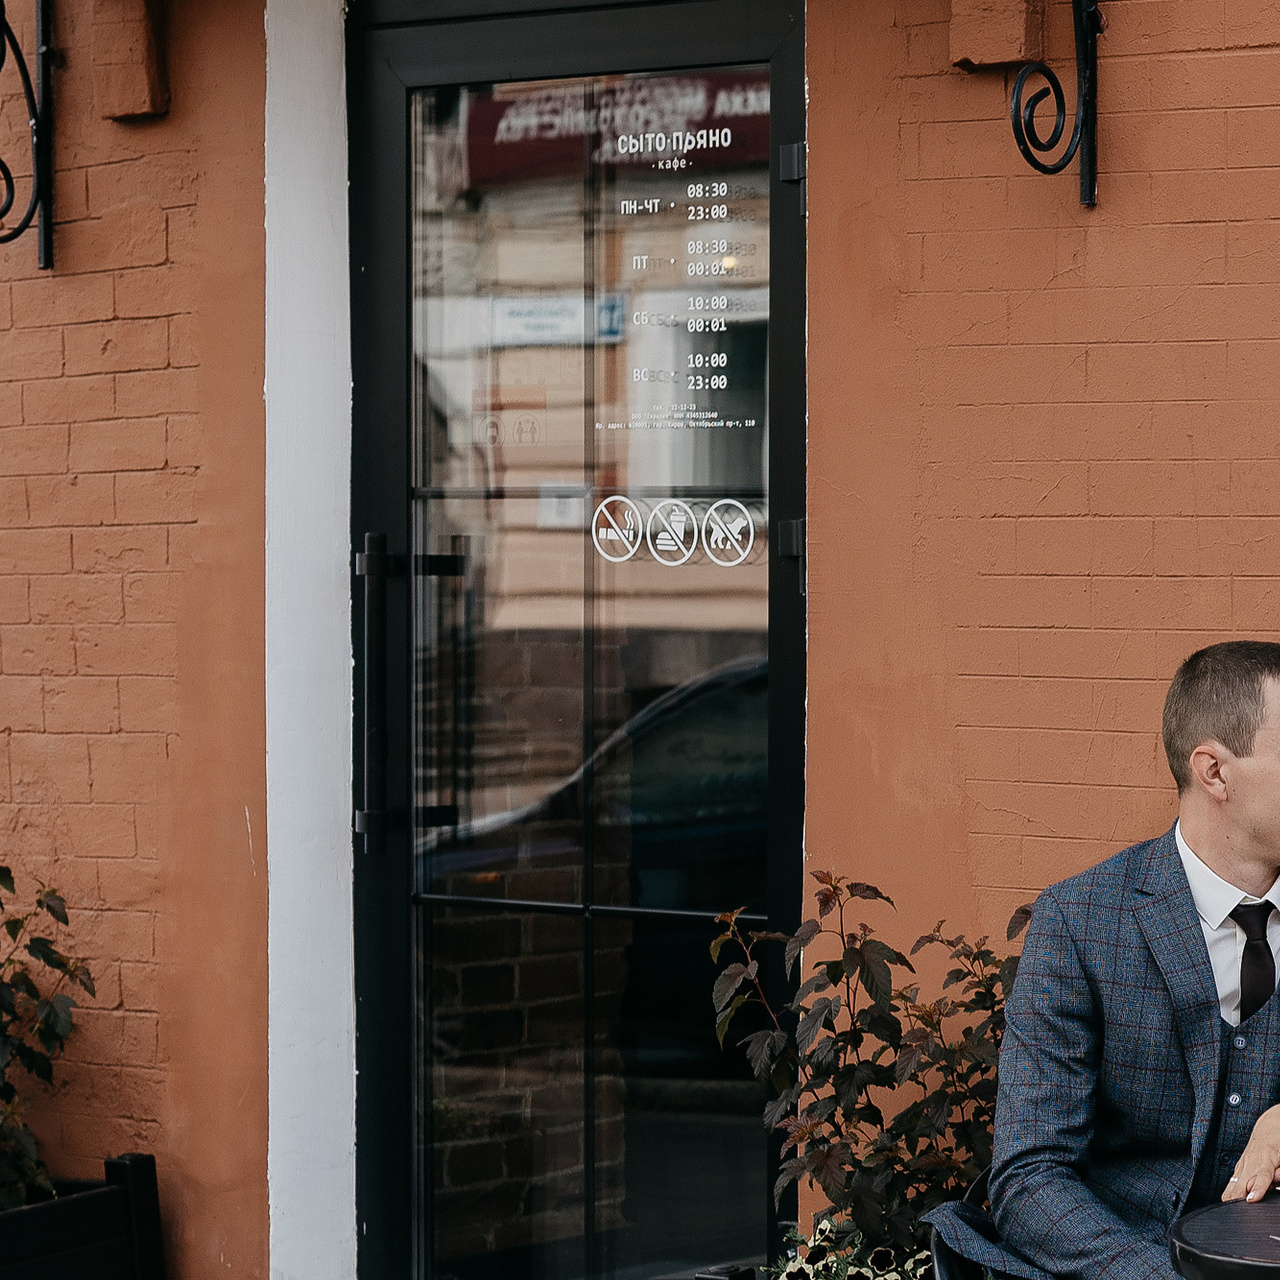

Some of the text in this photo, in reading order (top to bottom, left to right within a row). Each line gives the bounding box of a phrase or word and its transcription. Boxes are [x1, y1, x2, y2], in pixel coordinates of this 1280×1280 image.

[687, 182, 728, 198] 08:30
[620, 199, 661, 215] ПН-ЧТ
[687, 204, 728, 220] 23:00
[687, 239, 728, 254] 08:30
[632, 255, 649, 270] ПТ
[687, 262, 727, 276] 00:01
[687, 296, 728, 311] 10:00
[632, 311, 649, 325] СБ
[687, 317, 727, 333] 00:01
[687, 353, 728, 368] 10:00
[632, 368, 649, 382] ВС
[687, 375, 728, 390] 23:00
